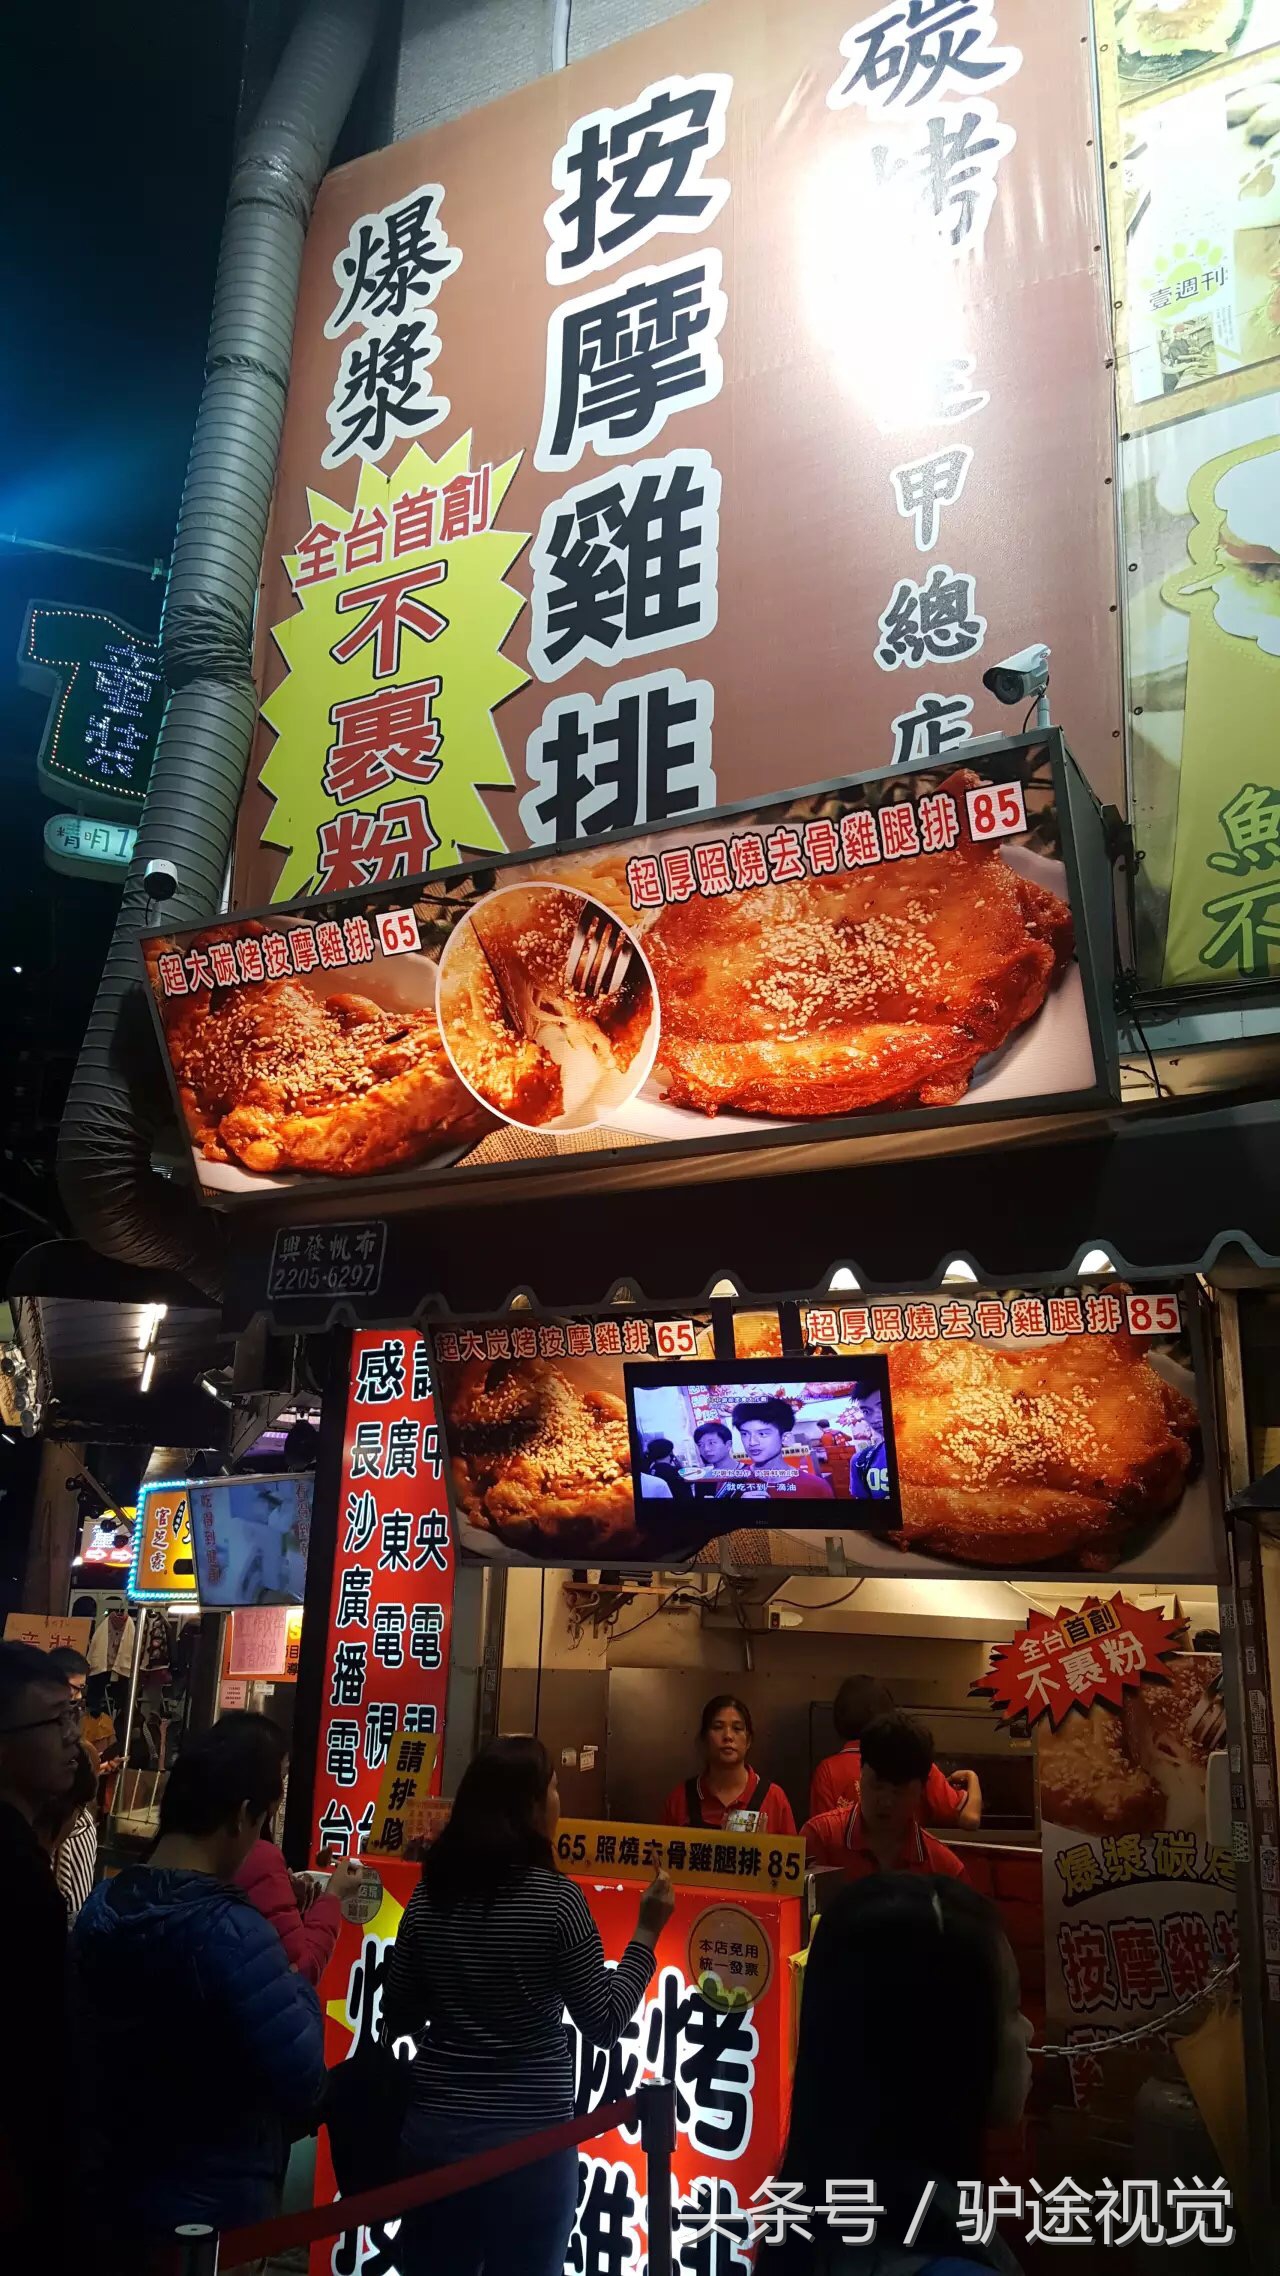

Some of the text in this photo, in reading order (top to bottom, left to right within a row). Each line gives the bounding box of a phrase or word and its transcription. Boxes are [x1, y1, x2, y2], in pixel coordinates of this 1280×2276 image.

[1149, 266, 1227, 312] 壹週刊
[328, 190, 456, 462] 爆漿
[532, 80, 722, 842] 按摩雞排
[295, 466, 491, 588] 全台首創
[316, 558, 449, 895] 不裹粉
[627, 787, 1021, 908] 超厚照燒去骨雞腿排 85
[158, 914, 417, 997] 超大碳烤按摩雞排 65
[279, 1229, 377, 1263] 興發帆布
[435, 1319, 694, 1363] 超大炭烤按摩雞排 65
[806, 1294, 1177, 1345] 超厚照燒去骨雞腿排 85
[1018, 1603, 1117, 1664] 全台首創
[1017, 1630, 1148, 1706] 不裹粉
[767, 1850, 801, 1881] 85
[699, 1956, 759, 1977] 統一發票
